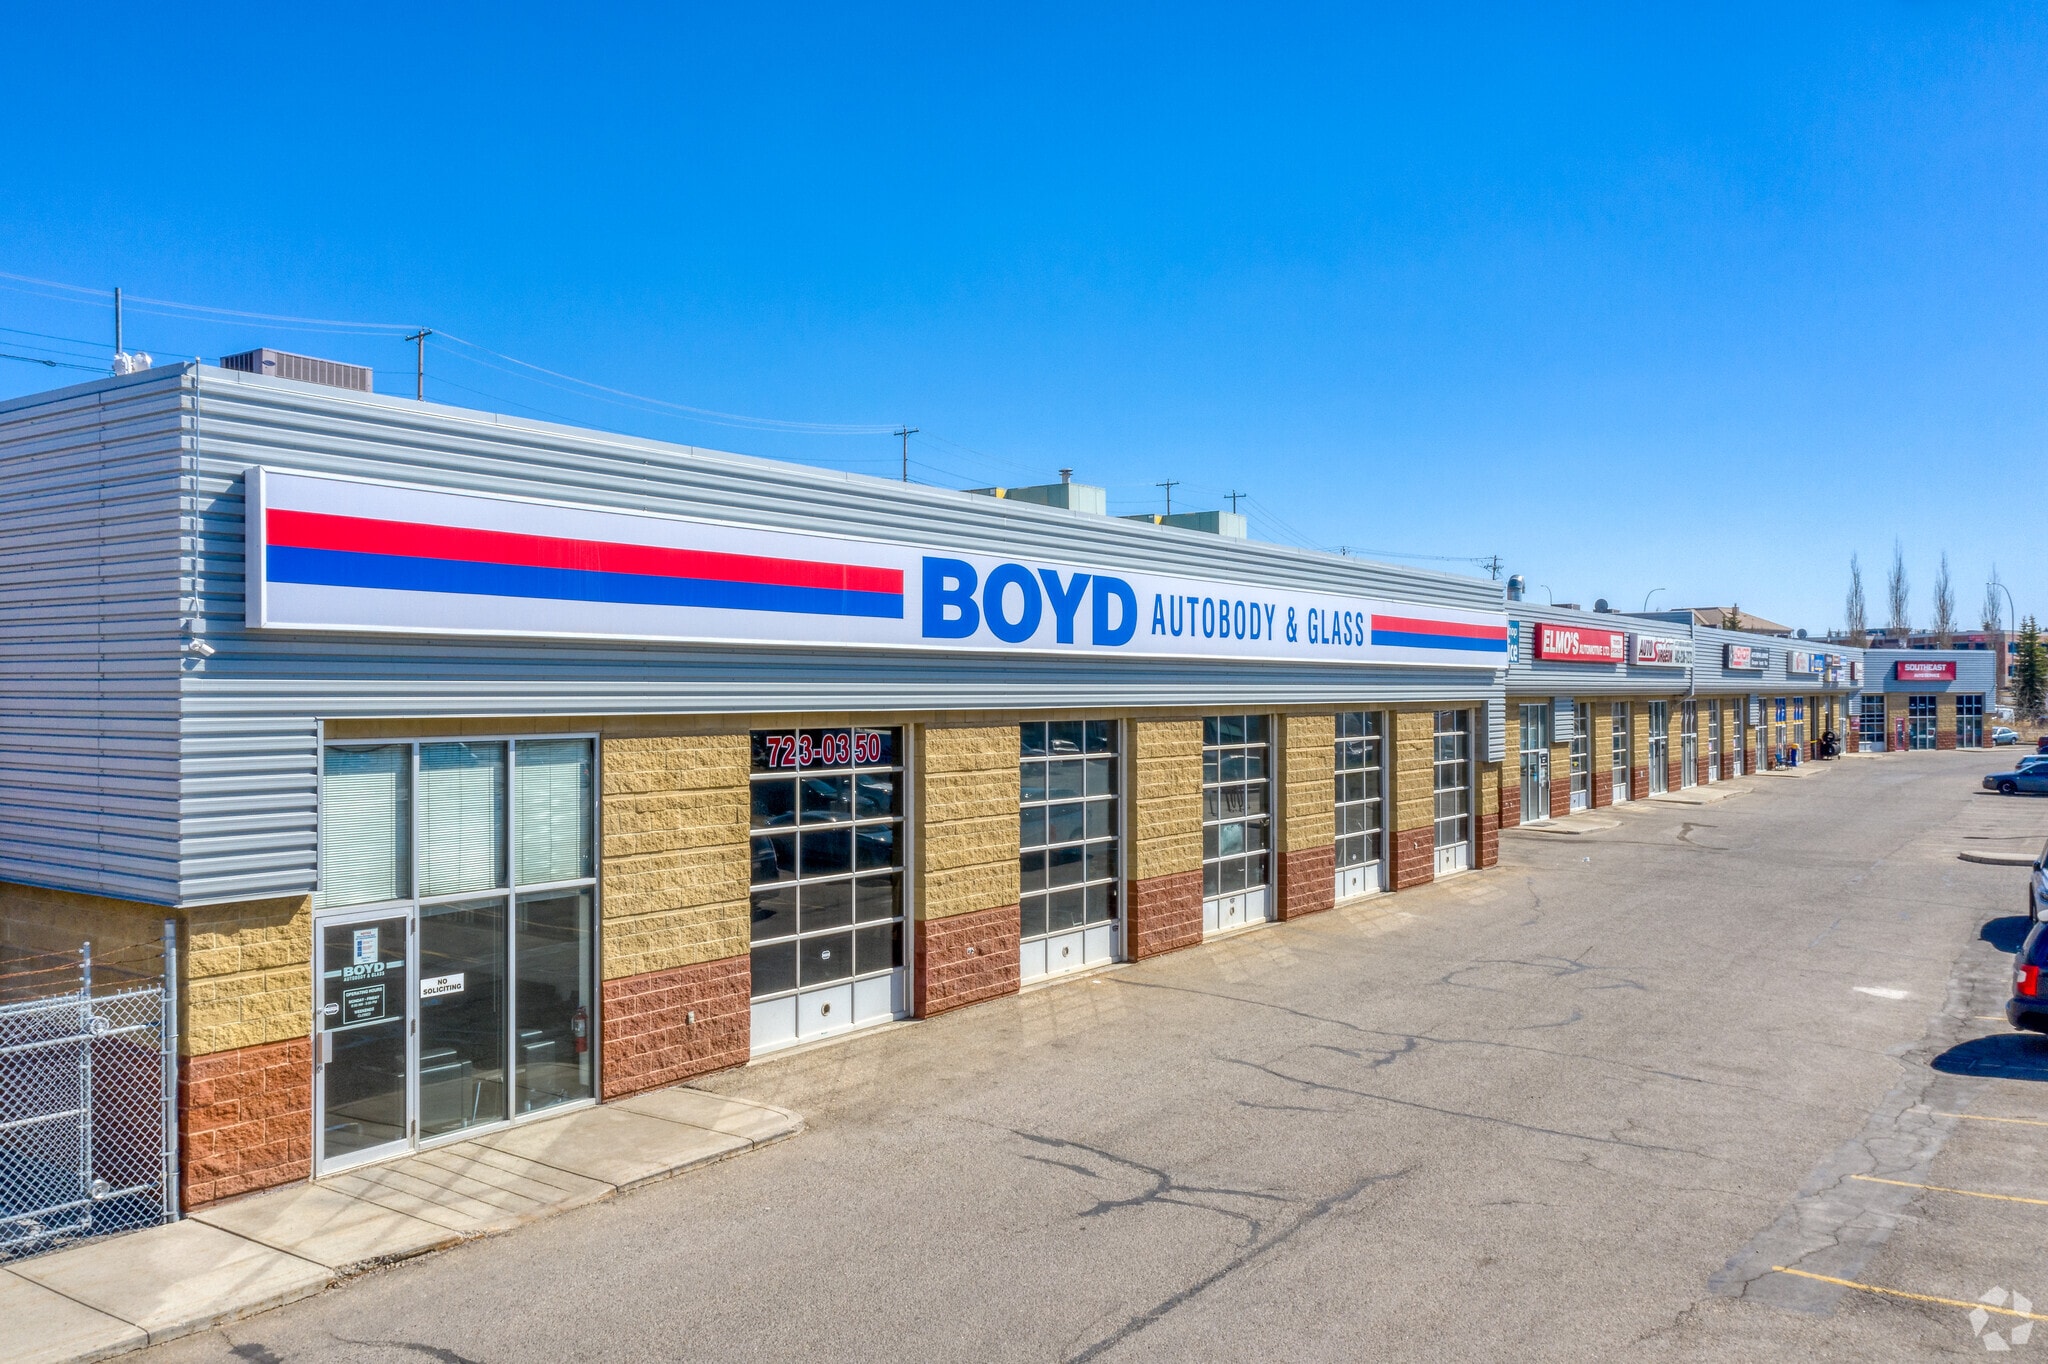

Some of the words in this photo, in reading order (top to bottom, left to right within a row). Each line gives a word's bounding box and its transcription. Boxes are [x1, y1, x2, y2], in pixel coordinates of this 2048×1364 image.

[921, 555, 1138, 647] BOYD
[1151, 593, 1276, 642] AUTOBODY
[1286, 607, 1298, 643] &
[1307, 607, 1364, 647] GLASS
[1543, 629, 1579, 655] ELMO'S
[1639, 640, 1653, 656] AUTO
[1904, 663, 1947, 671] SOUTHEAST
[767, 733, 881, 767] 723-0350
[343, 962, 385, 977] BOYD
[343, 973, 366, 982] AUTOBODY
[371, 970, 385, 978] GLASS
[423, 983, 462, 995] SOLICITING
